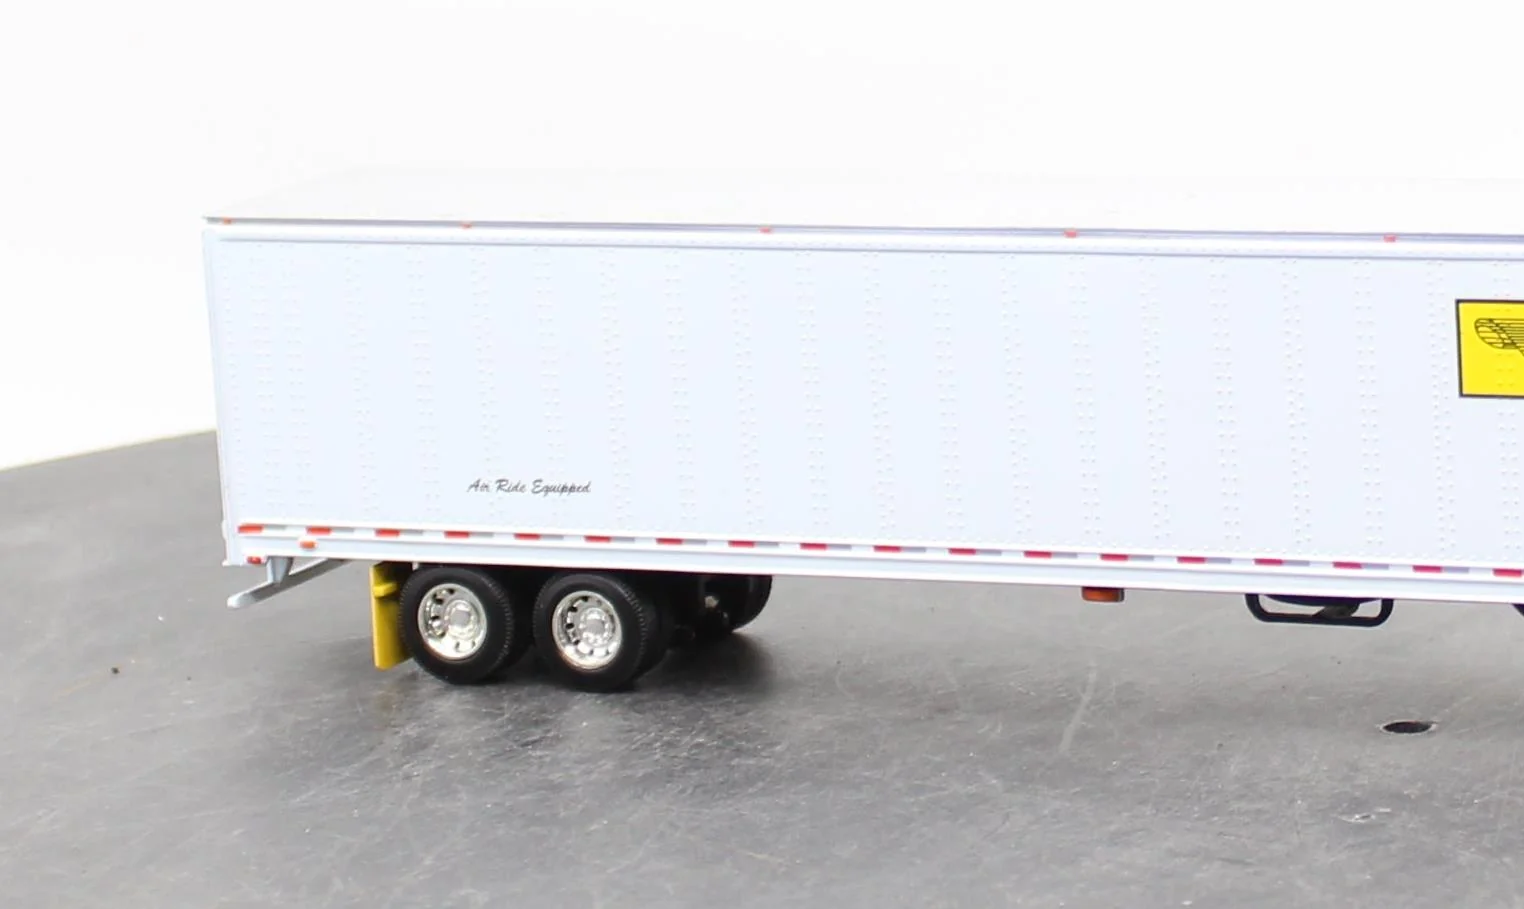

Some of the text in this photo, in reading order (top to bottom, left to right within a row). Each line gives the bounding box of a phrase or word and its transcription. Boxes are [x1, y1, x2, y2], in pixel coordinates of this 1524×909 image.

[467, 478, 592, 497] Air Ride Equipped
